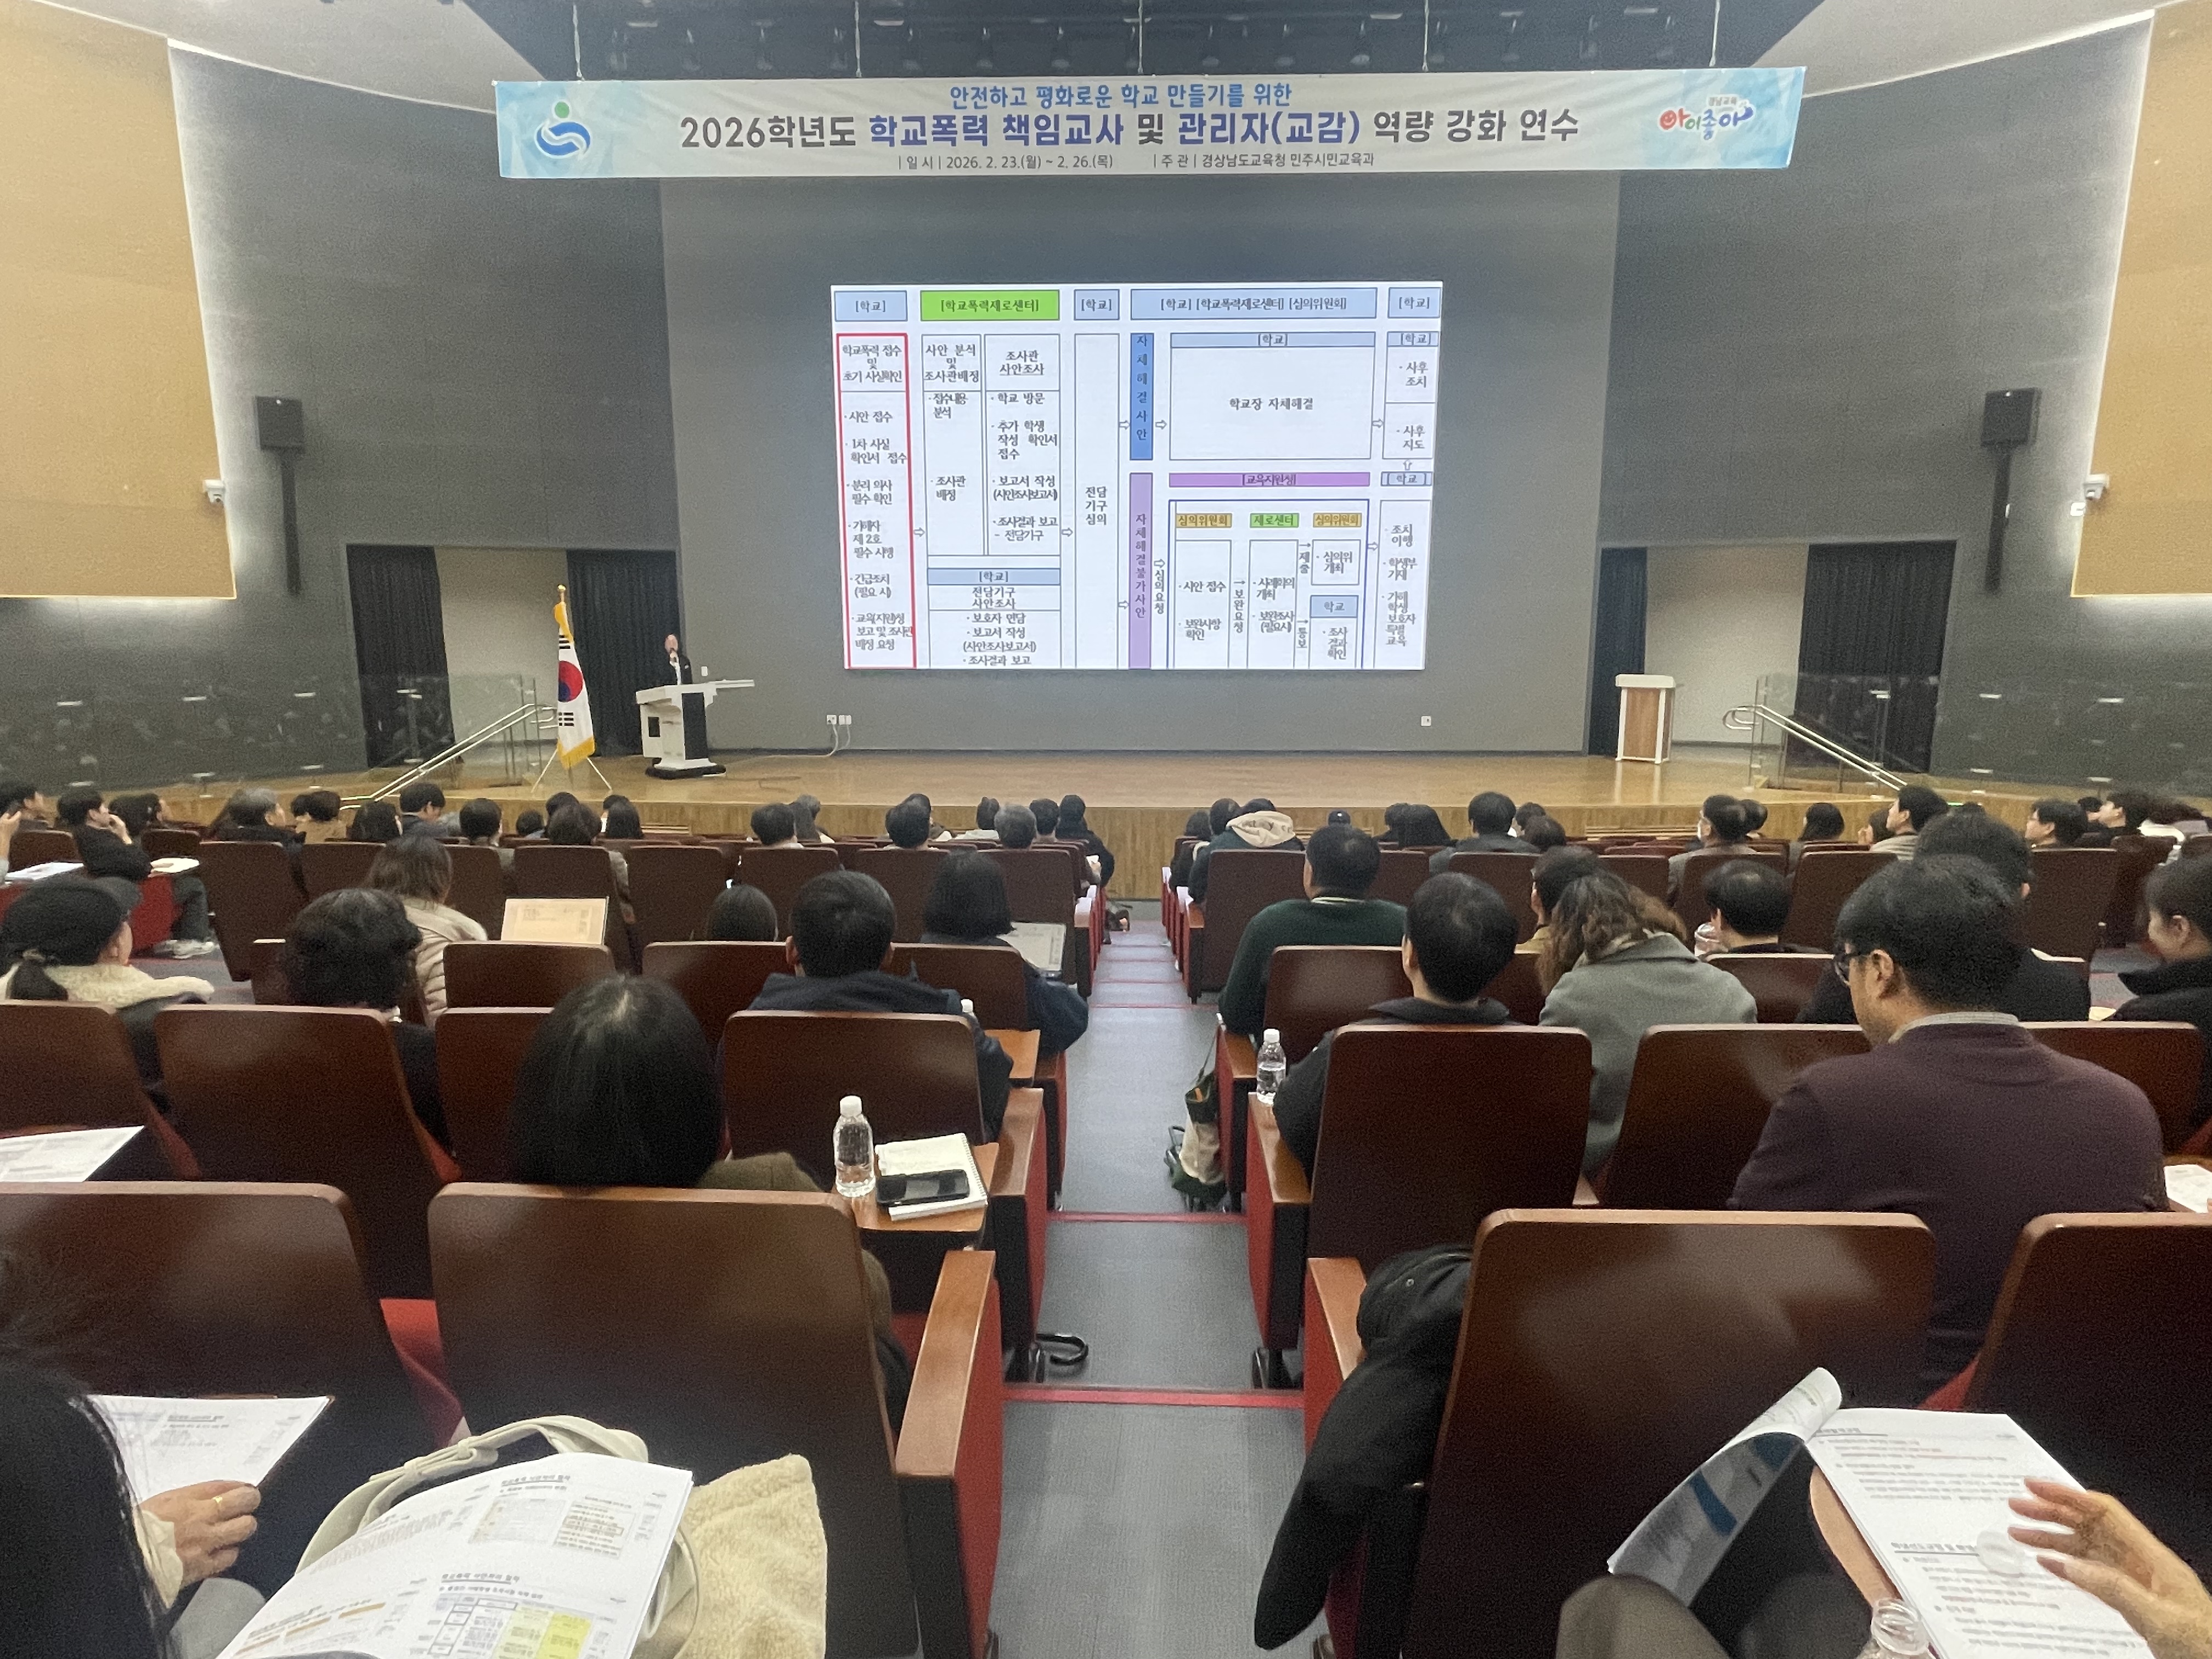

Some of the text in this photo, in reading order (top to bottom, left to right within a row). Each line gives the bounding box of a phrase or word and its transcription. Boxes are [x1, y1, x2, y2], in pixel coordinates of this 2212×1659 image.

[950, 82, 1292, 110] 안전하고 평화로운 학교 만들기를 위한
[680, 109, 1578, 148] 2026학년도 학교폭력 책임교사 및 관리자(교감) 역량 강화 연수
[947, 156, 981, 169] 2026.
[986, 156, 997, 170] 2.
[1002, 155, 1041, 170] 23.(월)
[1058, 156, 1068, 169] 2.
[1073, 155, 1113, 169] 26.(목)
[1203, 153, 1285, 168] 경상남도교육청
[1290, 153, 1374, 167] 민주시민교육과
[856, 300, 885, 313] [학교]
[941, 300, 1039, 312] [학교폭력제로센터]
[1081, 299, 1112, 312] [학교]
[1161, 297, 1346, 311] [학교] [학교폭력제로센터] [심의위원회]
[1400, 297, 1430, 309] [학교]
[1258, 334, 1288, 346] [학교]
[1401, 333, 1431, 346] [학교]
[842, 345, 902, 357] 학교폭력 접수
[926, 344, 975, 357] 사안 분석
[1006, 350, 1039, 362] 조사관
[867, 358, 877, 369] 및
[946, 357, 956, 369] 및
[1406, 361, 1429, 374] 사후
[999, 363, 1044, 376] 사안조사
[924, 370, 979, 382] 조사관배정
[1406, 376, 1426, 388] 조치
[998, 393, 1045, 404] 학교 방문
[1229, 398, 1313, 410] 학교장 자체해결
[849, 411, 893, 423] 사안 접수
[934, 407, 951, 419] 분석
[997, 420, 1045, 432] 추가 학생
[1403, 425, 1425, 437] 사후
[853, 438, 890, 450] 1차 사실
[998, 434, 1058, 446] 작성 확인서
[1403, 438, 1425, 451] 지도
[851, 452, 907, 464] 확인서 접수
[998, 448, 1020, 460] 접수
[853, 479, 892, 491] 분리 의사
[935, 476, 966, 487] 조사관
[998, 475, 1056, 487] 보고서 작성
[936, 489, 956, 501] 배정
[993, 489, 1058, 501] (사안조사보고서)
[1085, 487, 1107, 498] 전담
[1085, 500, 1107, 512] 기구
[997, 516, 1058, 528] 조사결과 보고
[1086, 514, 1107, 525] 심의
[1179, 515, 1228, 527] 심의위원회
[1254, 514, 1294, 527] 제로센터
[1005, 530, 1044, 541] 전담기구
[1391, 524, 1412, 535] 조치
[1391, 535, 1413, 547] 이행
[979, 571, 1008, 583] [학교]
[972, 586, 1015, 598] 전담기구
[1183, 581, 1226, 592] 사안 접수
[972, 599, 1016, 610] 사안조사
[1324, 601, 1345, 613] 학교
[972, 613, 1002, 624] 보호자
[856, 627, 874, 636] 보고
[877, 626, 887, 637] 및
[972, 627, 1025, 638] 보고서 작성
[963, 641, 1036, 652] (사안조사보고서)
[1386, 635, 1407, 647] 교육
[968, 655, 1031, 666] 조사결과 보고
